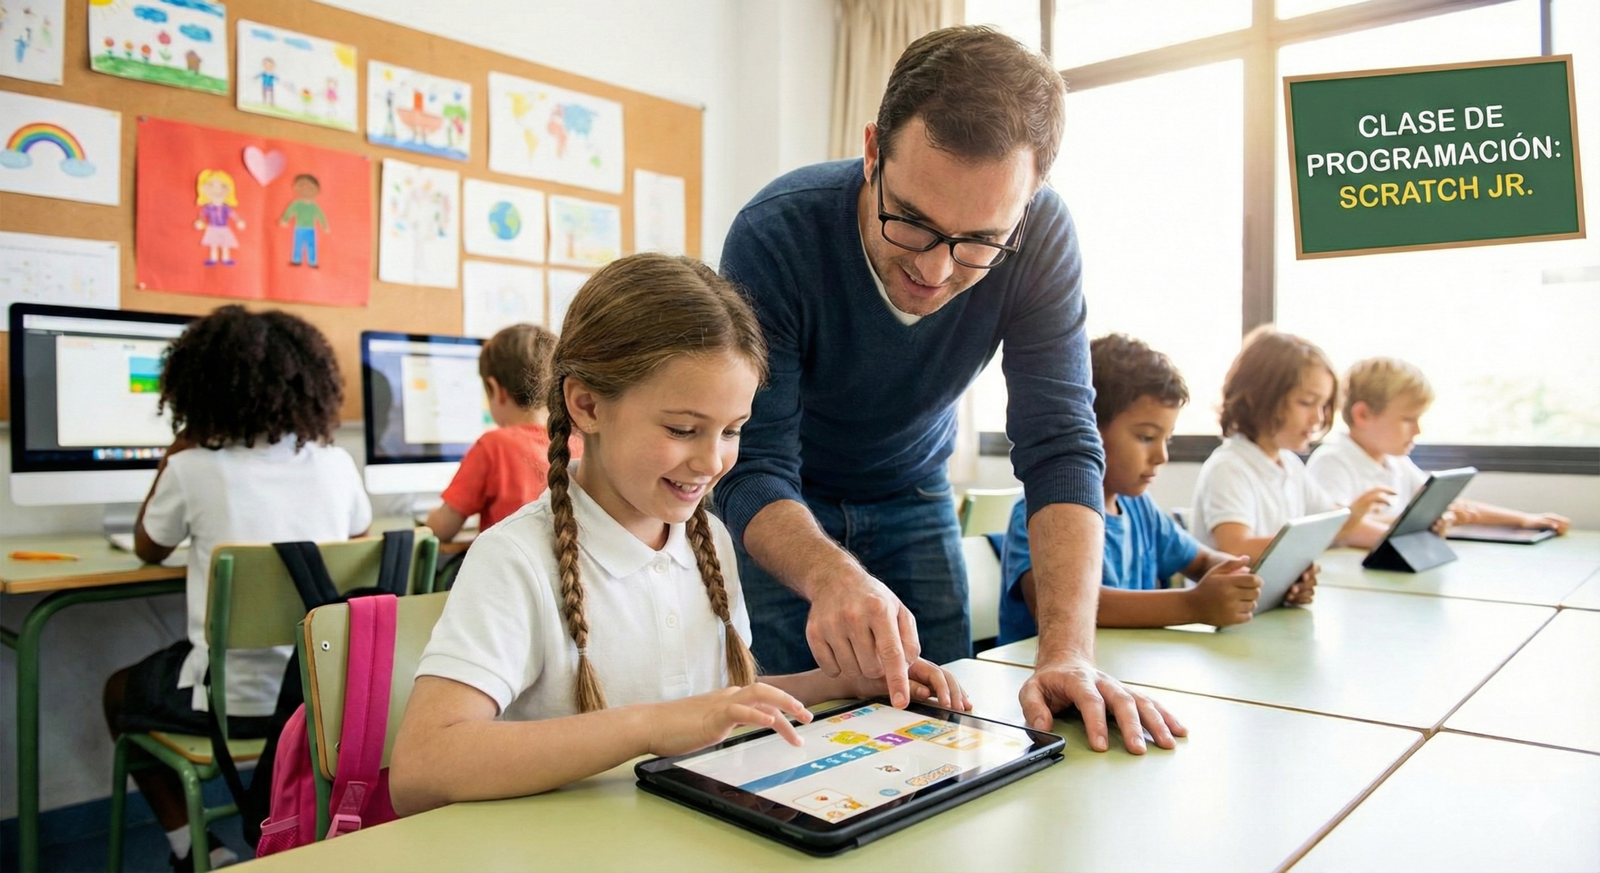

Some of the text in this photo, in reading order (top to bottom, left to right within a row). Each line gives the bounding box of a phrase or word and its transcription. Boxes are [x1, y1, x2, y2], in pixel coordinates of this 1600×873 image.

[1358, 104, 1505, 138] CLASE DE
[1307, 132, 1561, 178] PROGRAMACIÓN:
[1339, 173, 1533, 209] SCRATCH JR.
